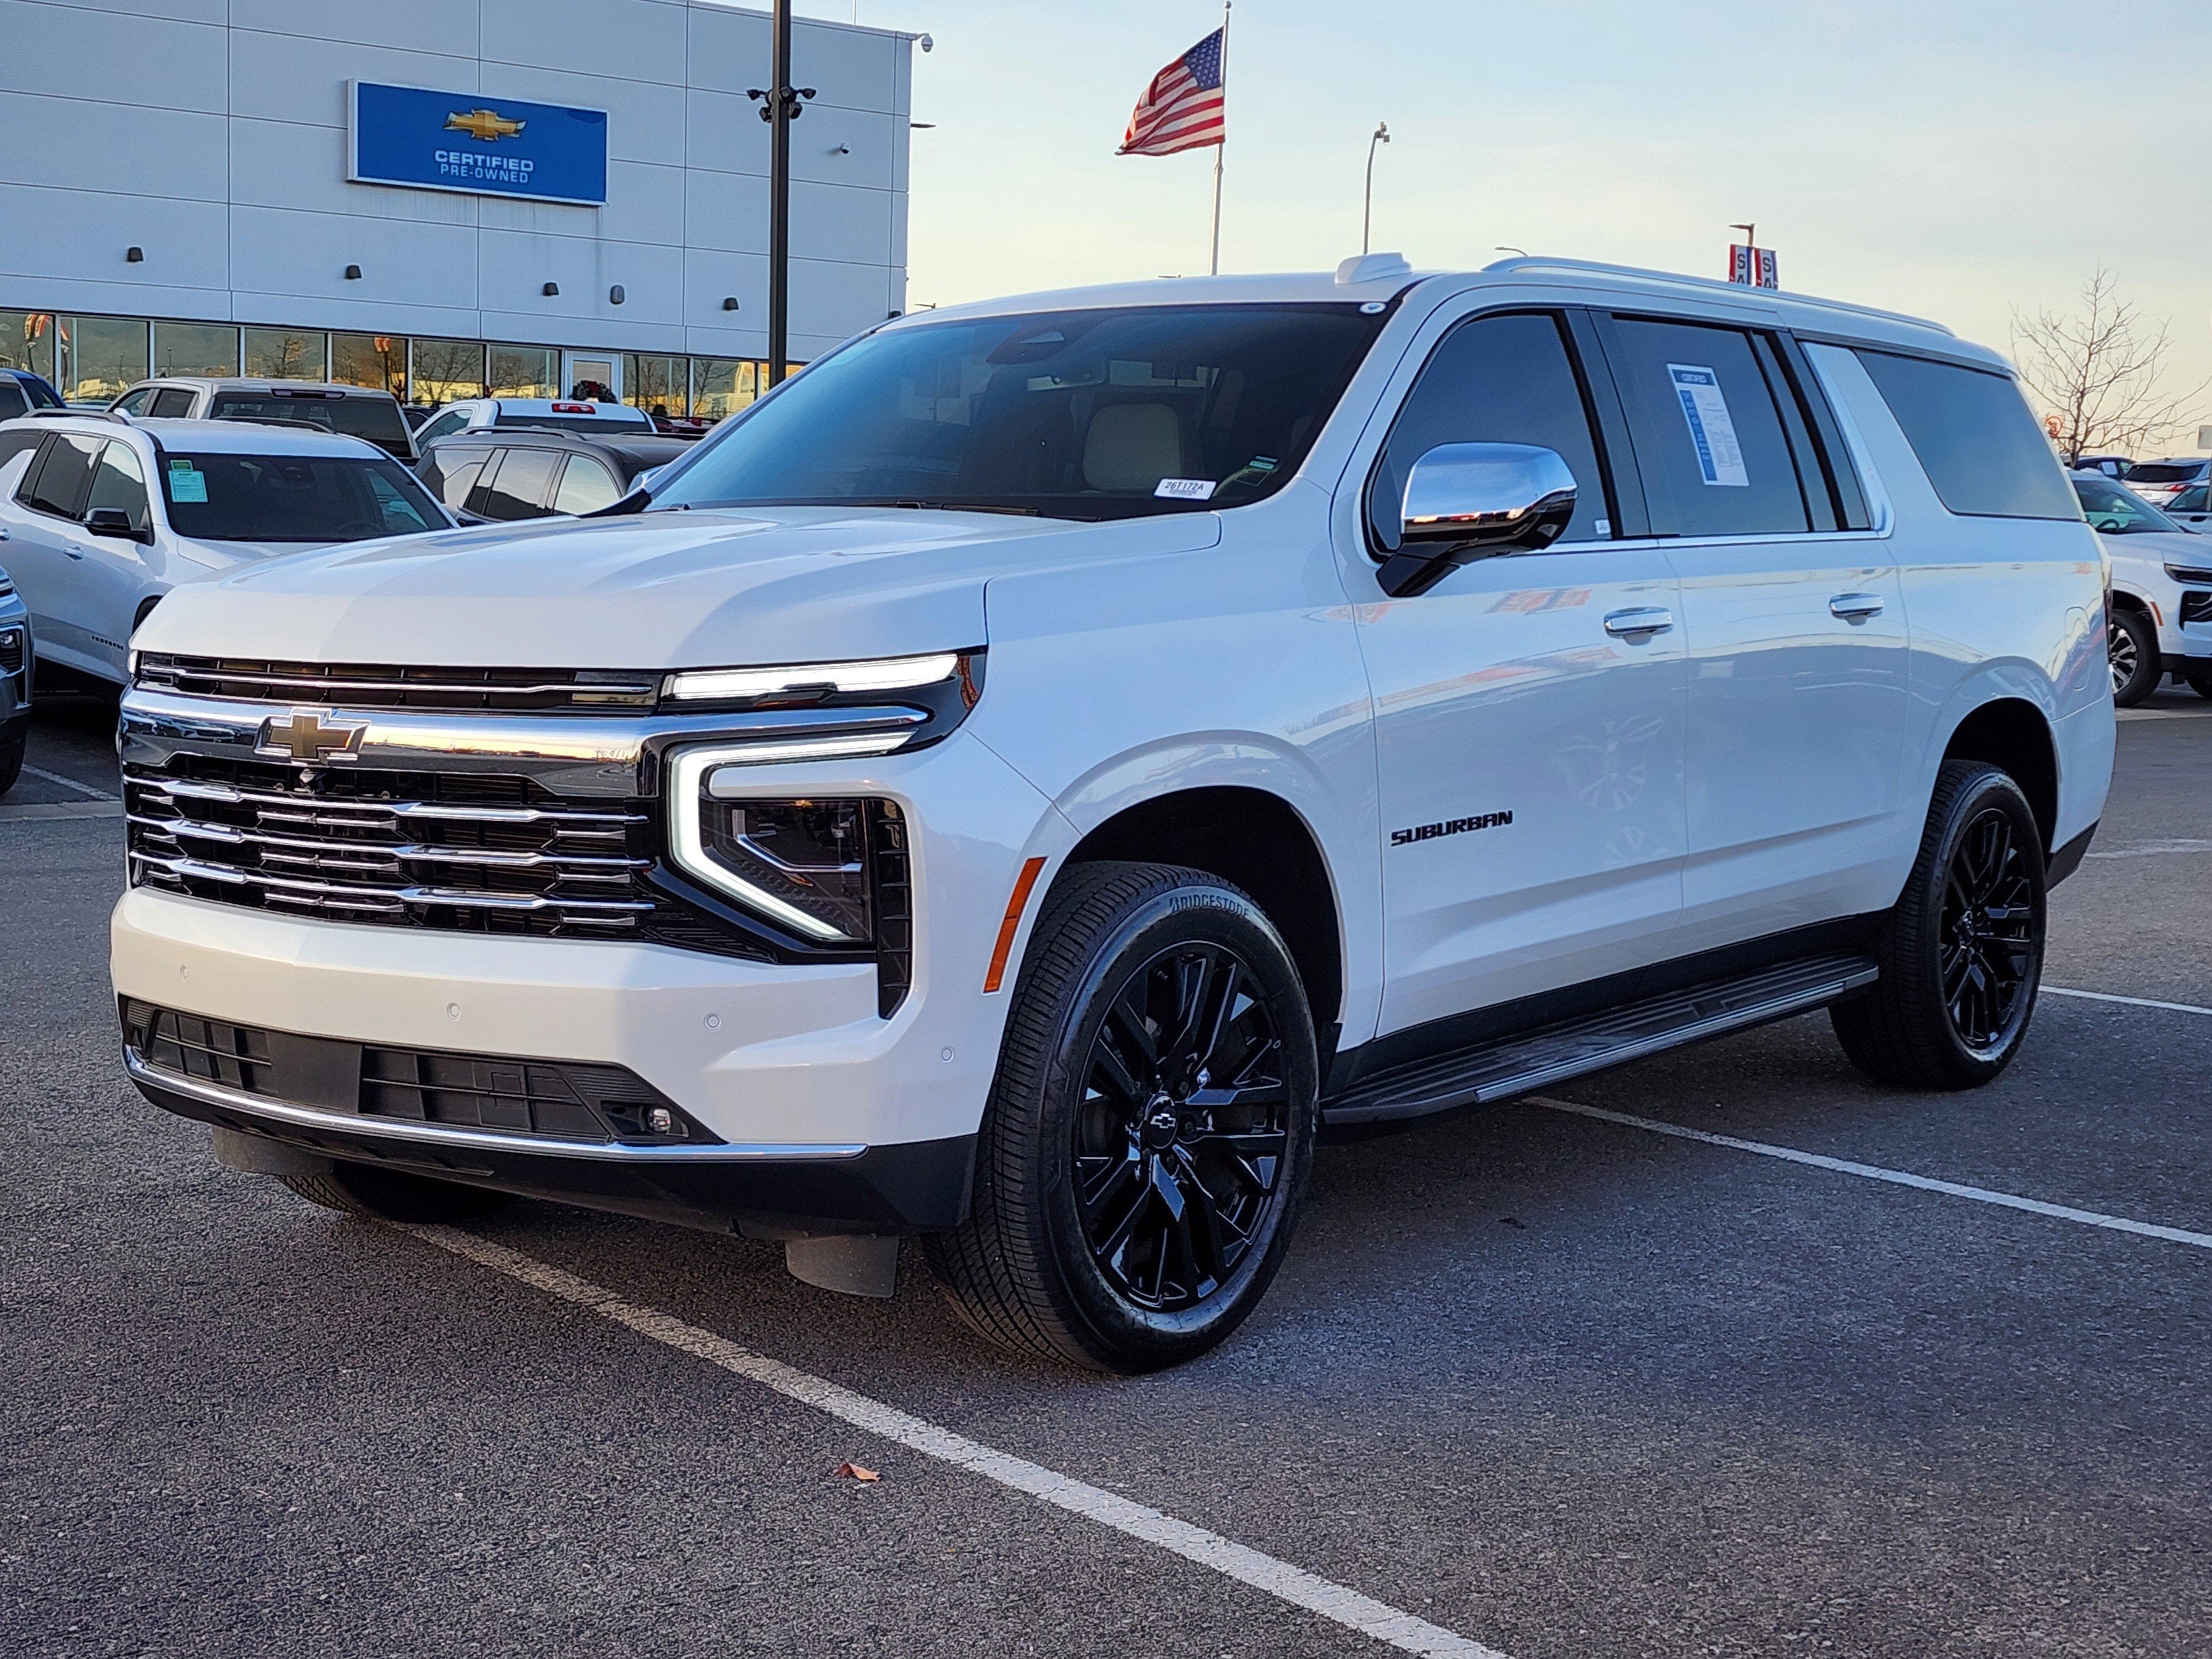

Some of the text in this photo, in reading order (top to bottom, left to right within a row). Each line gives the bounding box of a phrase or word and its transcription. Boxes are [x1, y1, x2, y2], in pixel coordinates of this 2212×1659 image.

[434, 150, 534, 172] CERTIFIED
[440, 163, 529, 183] PRE-OWNED
[1165, 481, 1204, 491] 26T172A
[1391, 811, 1513, 847] SUBURBAN
[1169, 894, 1250, 919] BRIDGESTONE
